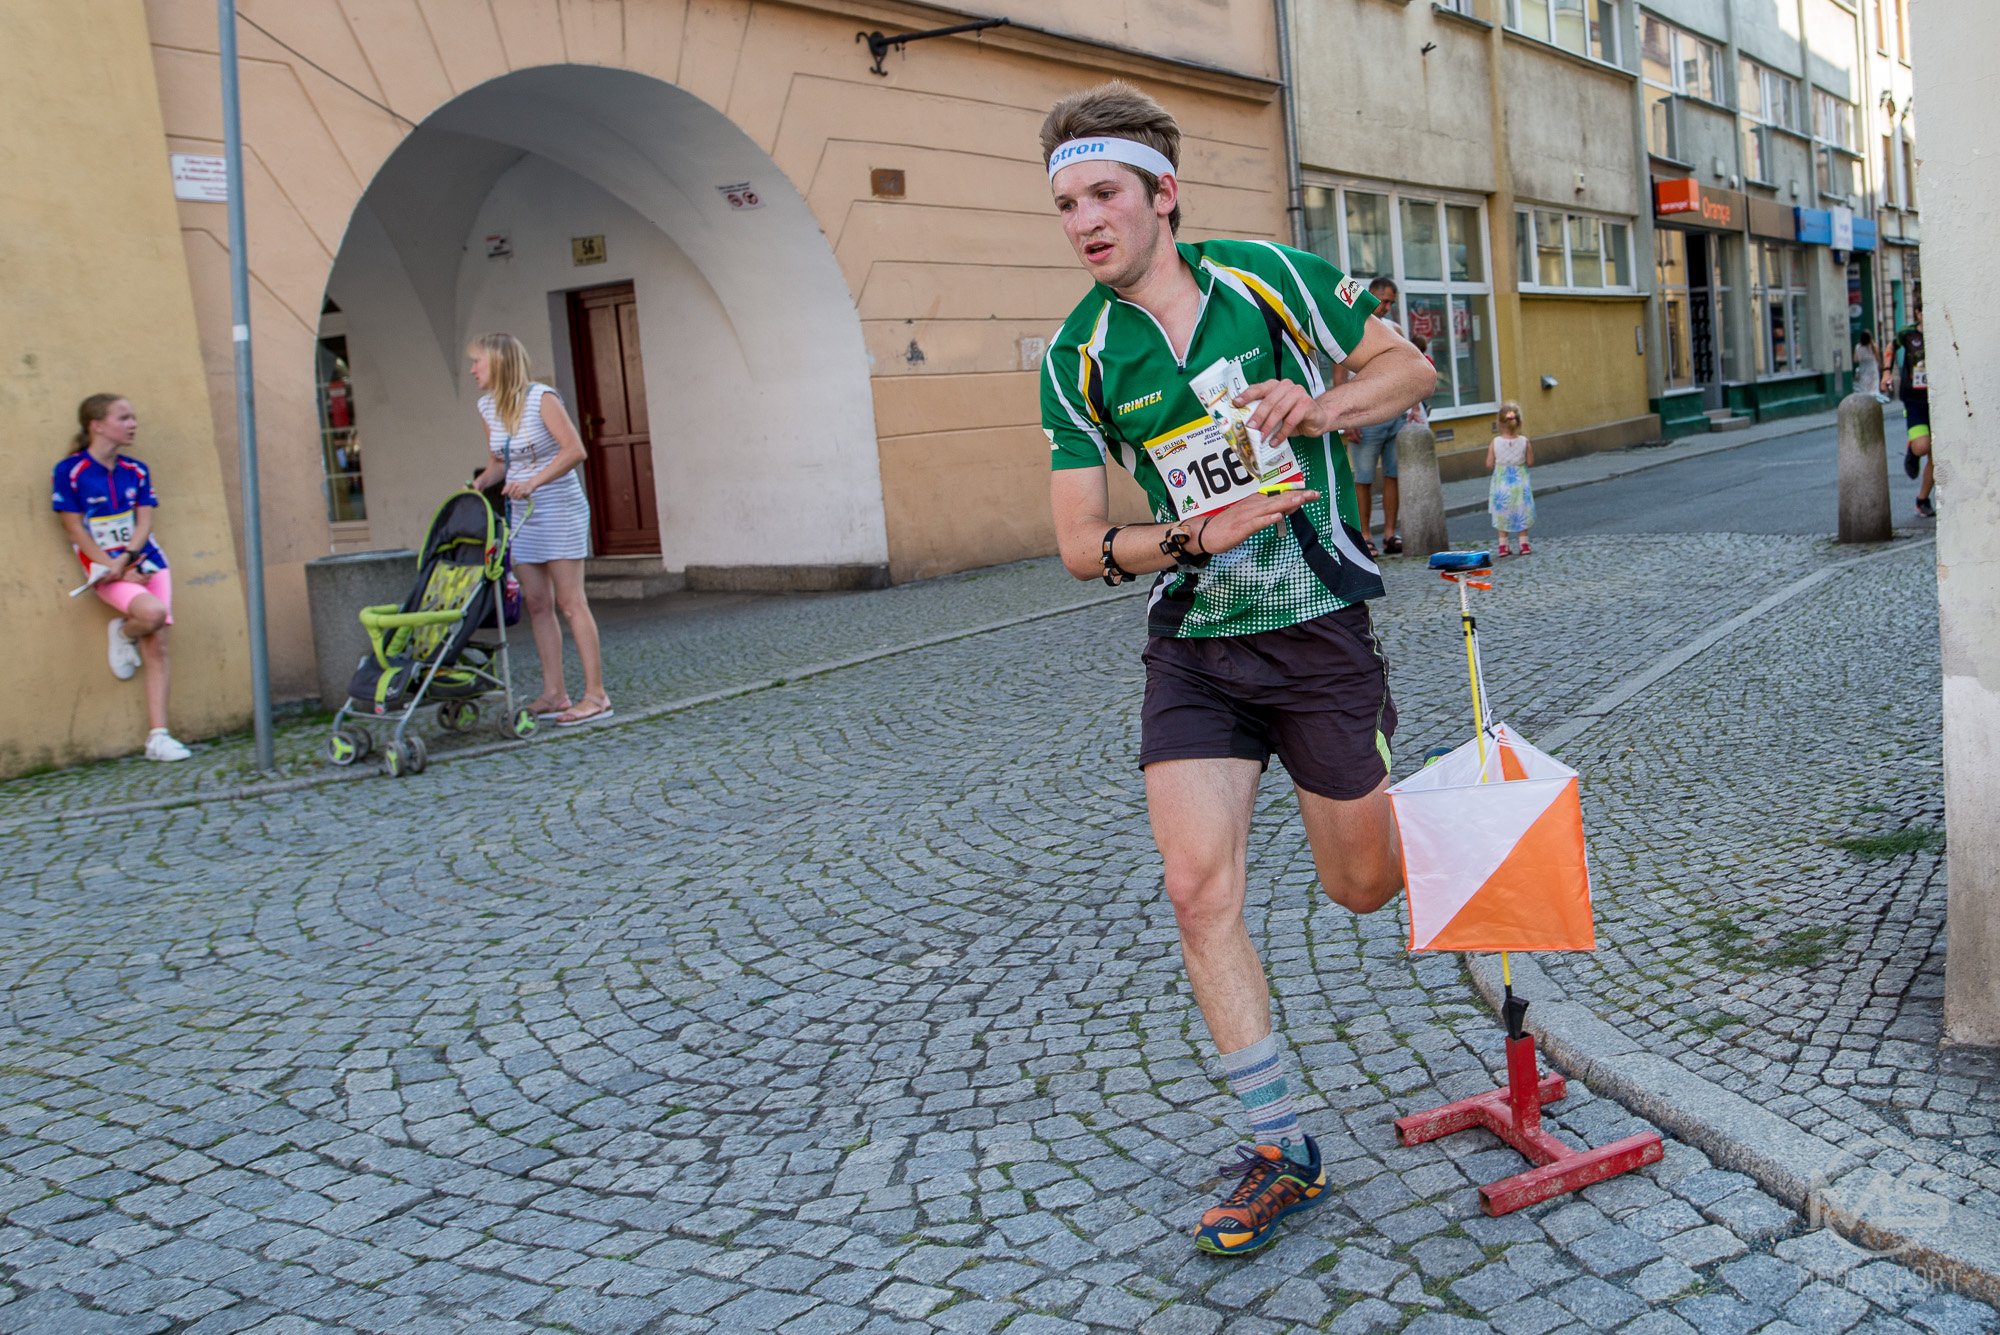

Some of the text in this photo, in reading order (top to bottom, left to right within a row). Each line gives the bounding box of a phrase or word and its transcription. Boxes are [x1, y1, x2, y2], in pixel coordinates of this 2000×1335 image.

[1050, 142, 1105, 167] otron
[1702, 195, 1731, 226] Orange
[1117, 389, 1162, 416] TRIMTEX
[1204, 424, 1218, 433] PREZY
[1163, 438, 1184, 452] JELENIA
